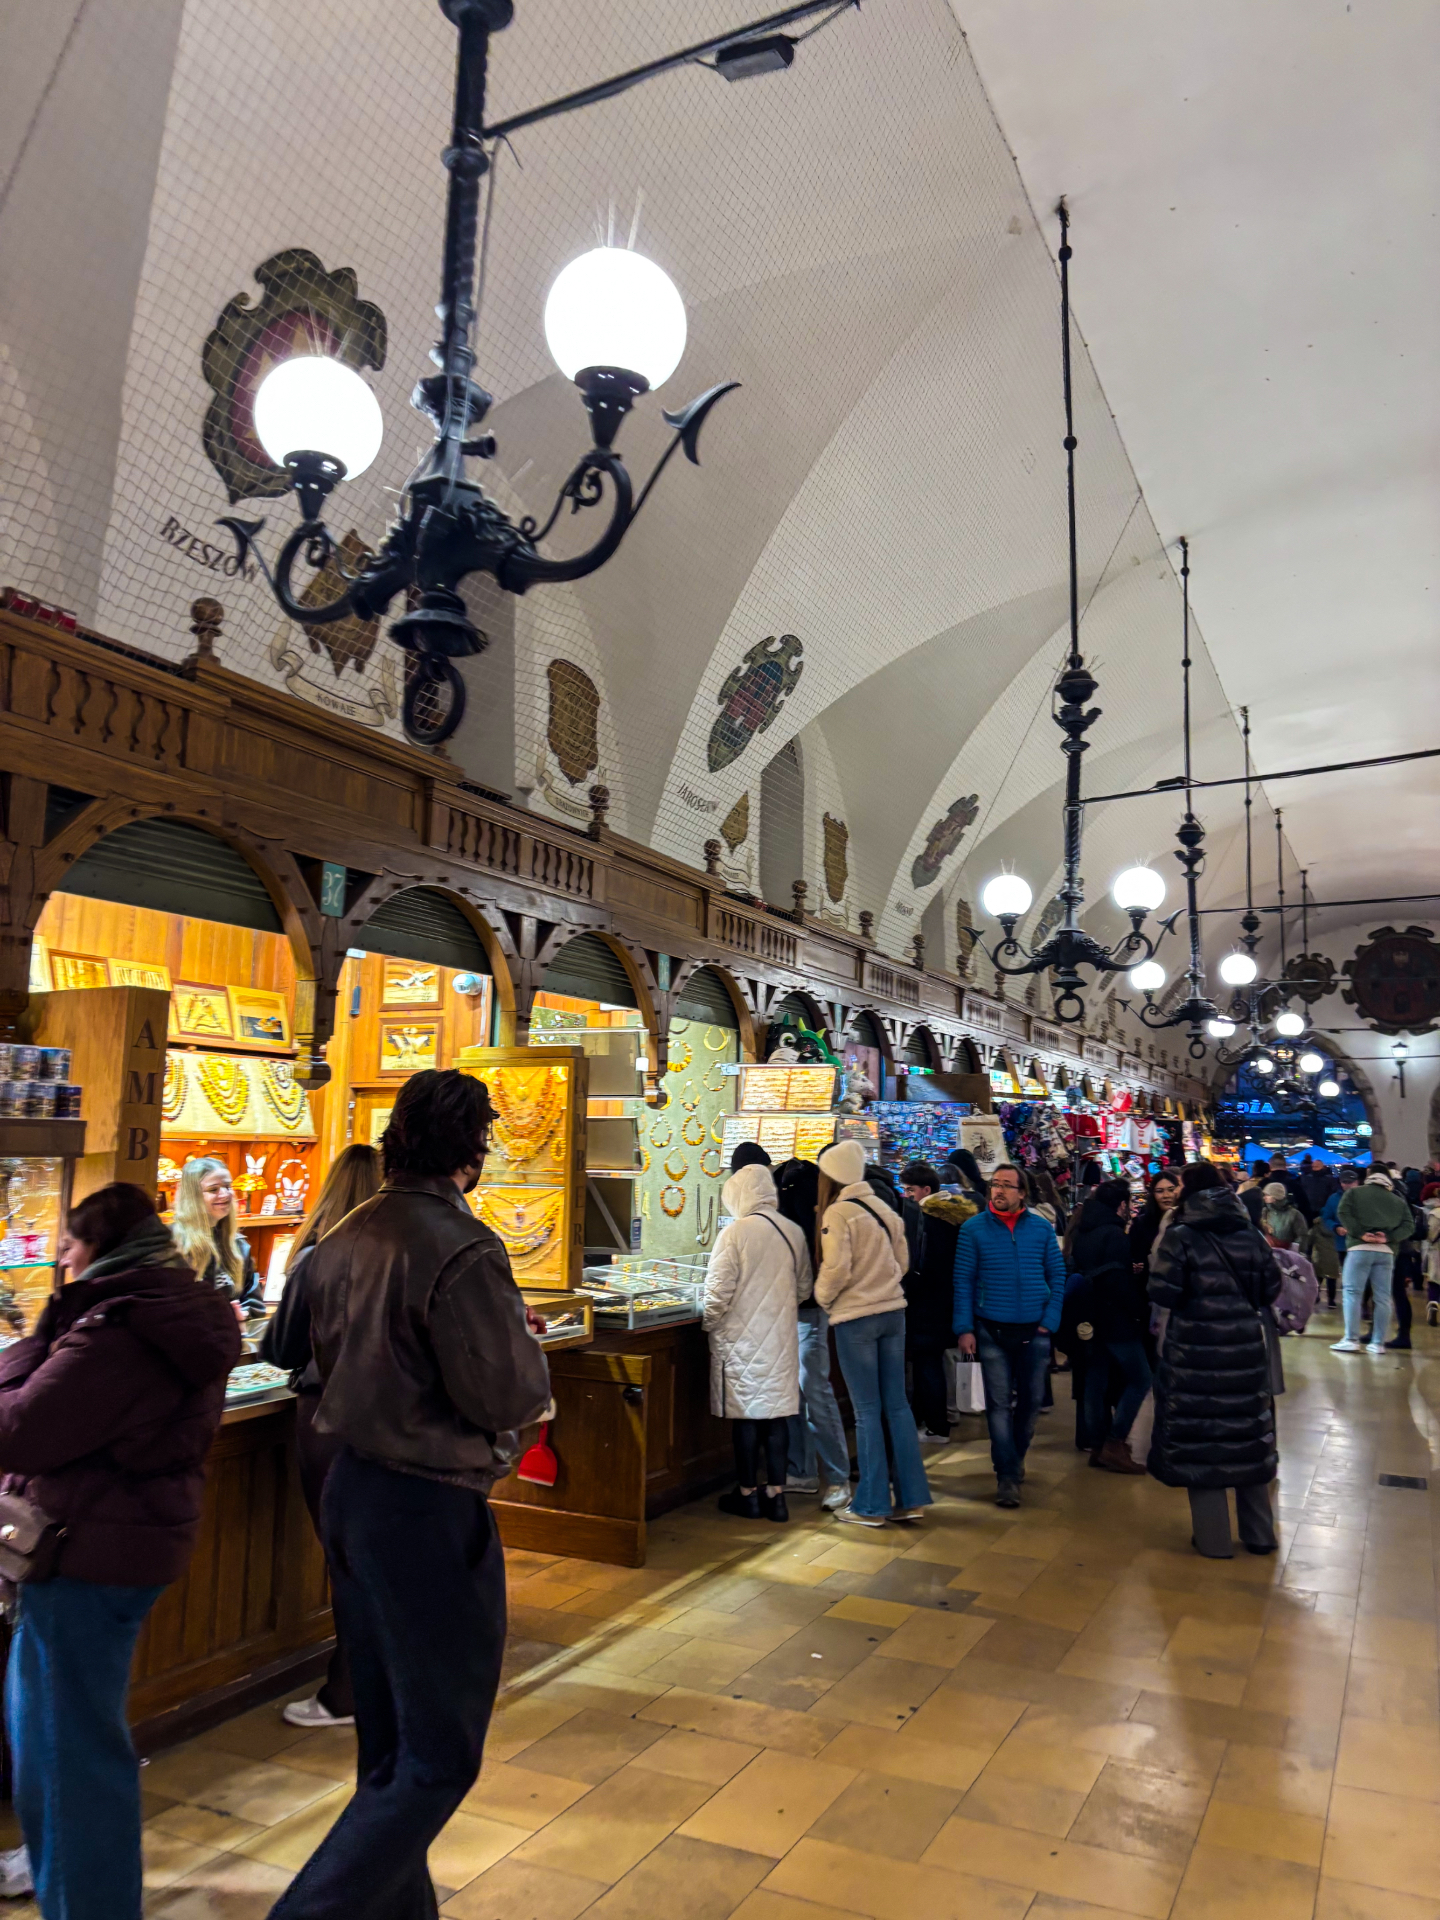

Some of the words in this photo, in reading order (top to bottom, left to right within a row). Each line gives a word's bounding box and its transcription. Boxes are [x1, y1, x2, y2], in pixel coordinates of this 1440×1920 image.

[321, 871, 345, 907] 37
[124, 1016, 160, 1188] AMB
[573, 1076, 589, 1247] AMBER
